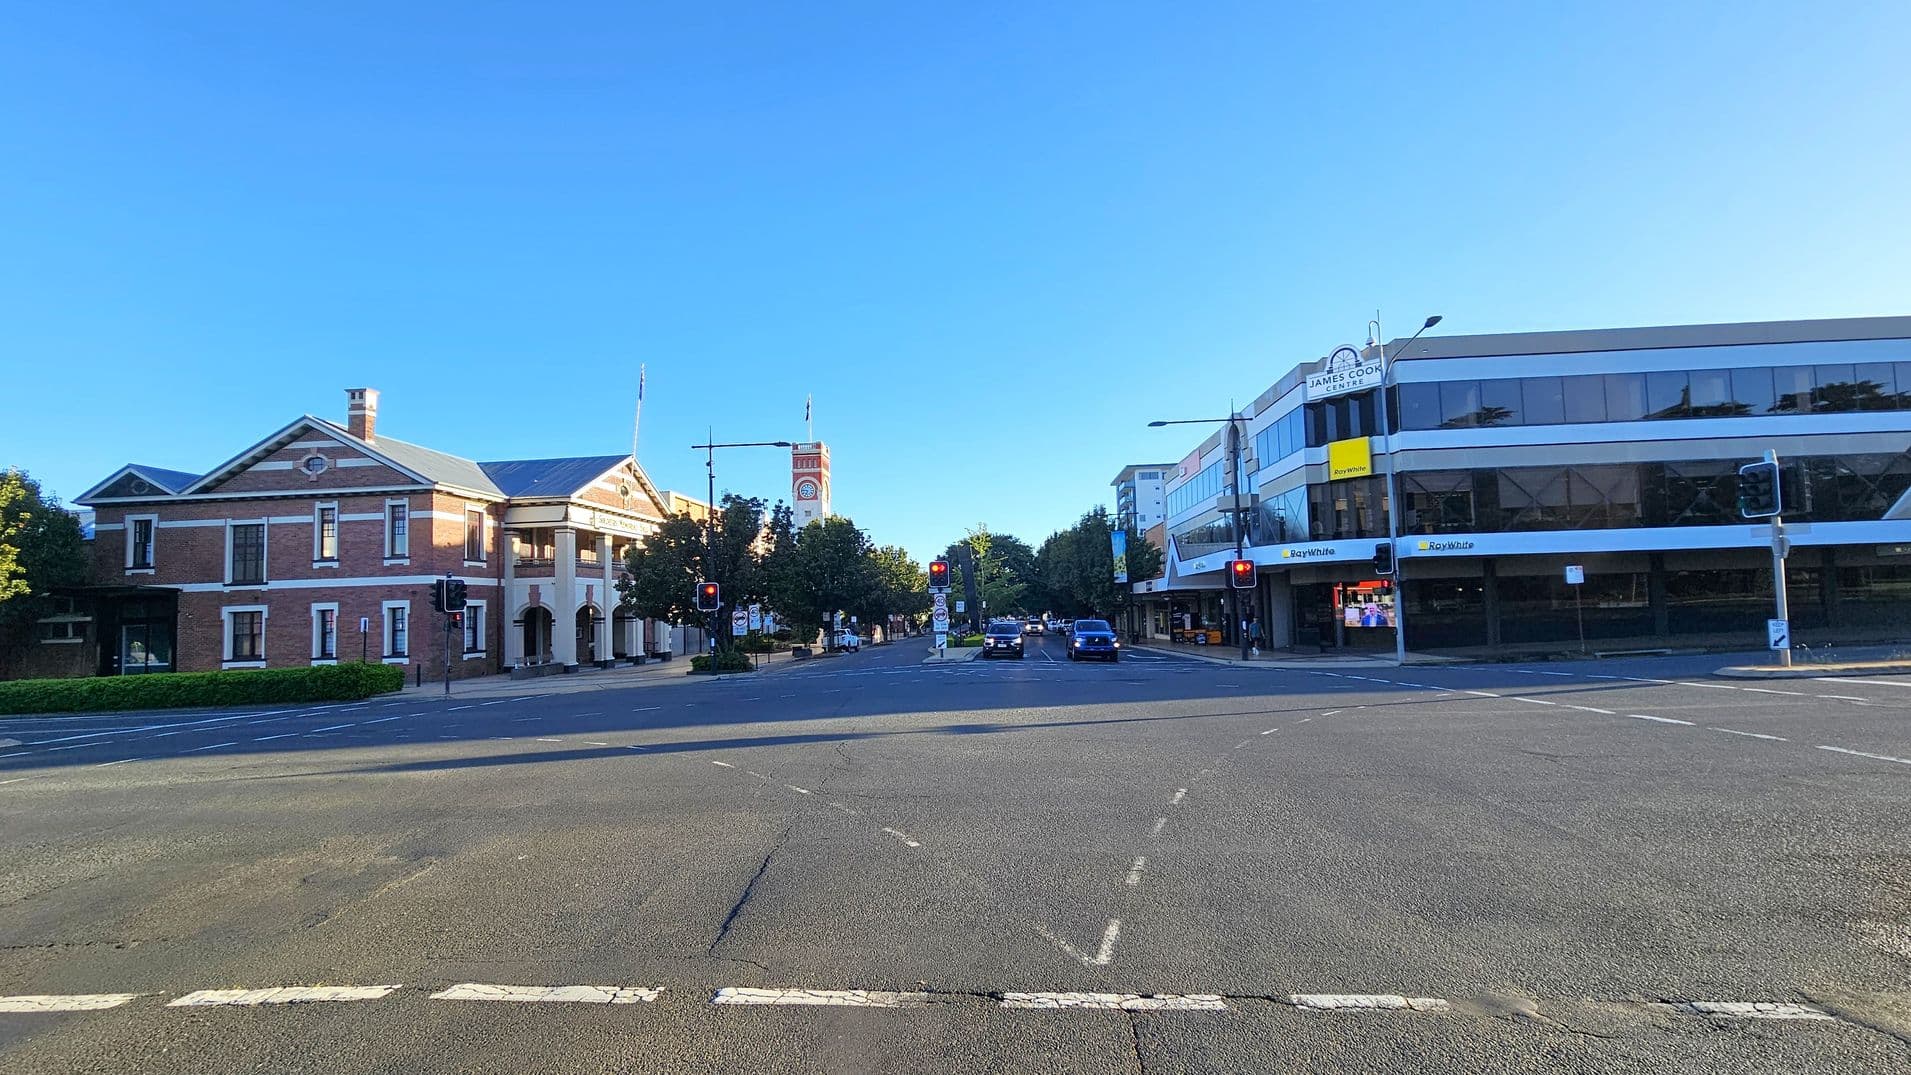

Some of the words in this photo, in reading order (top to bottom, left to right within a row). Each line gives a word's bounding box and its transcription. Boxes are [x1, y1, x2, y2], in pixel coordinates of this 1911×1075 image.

[1309, 374, 1345, 388] JAMES
[1349, 364, 1382, 379] COOK
[1326, 379, 1364, 392] CENTRE
